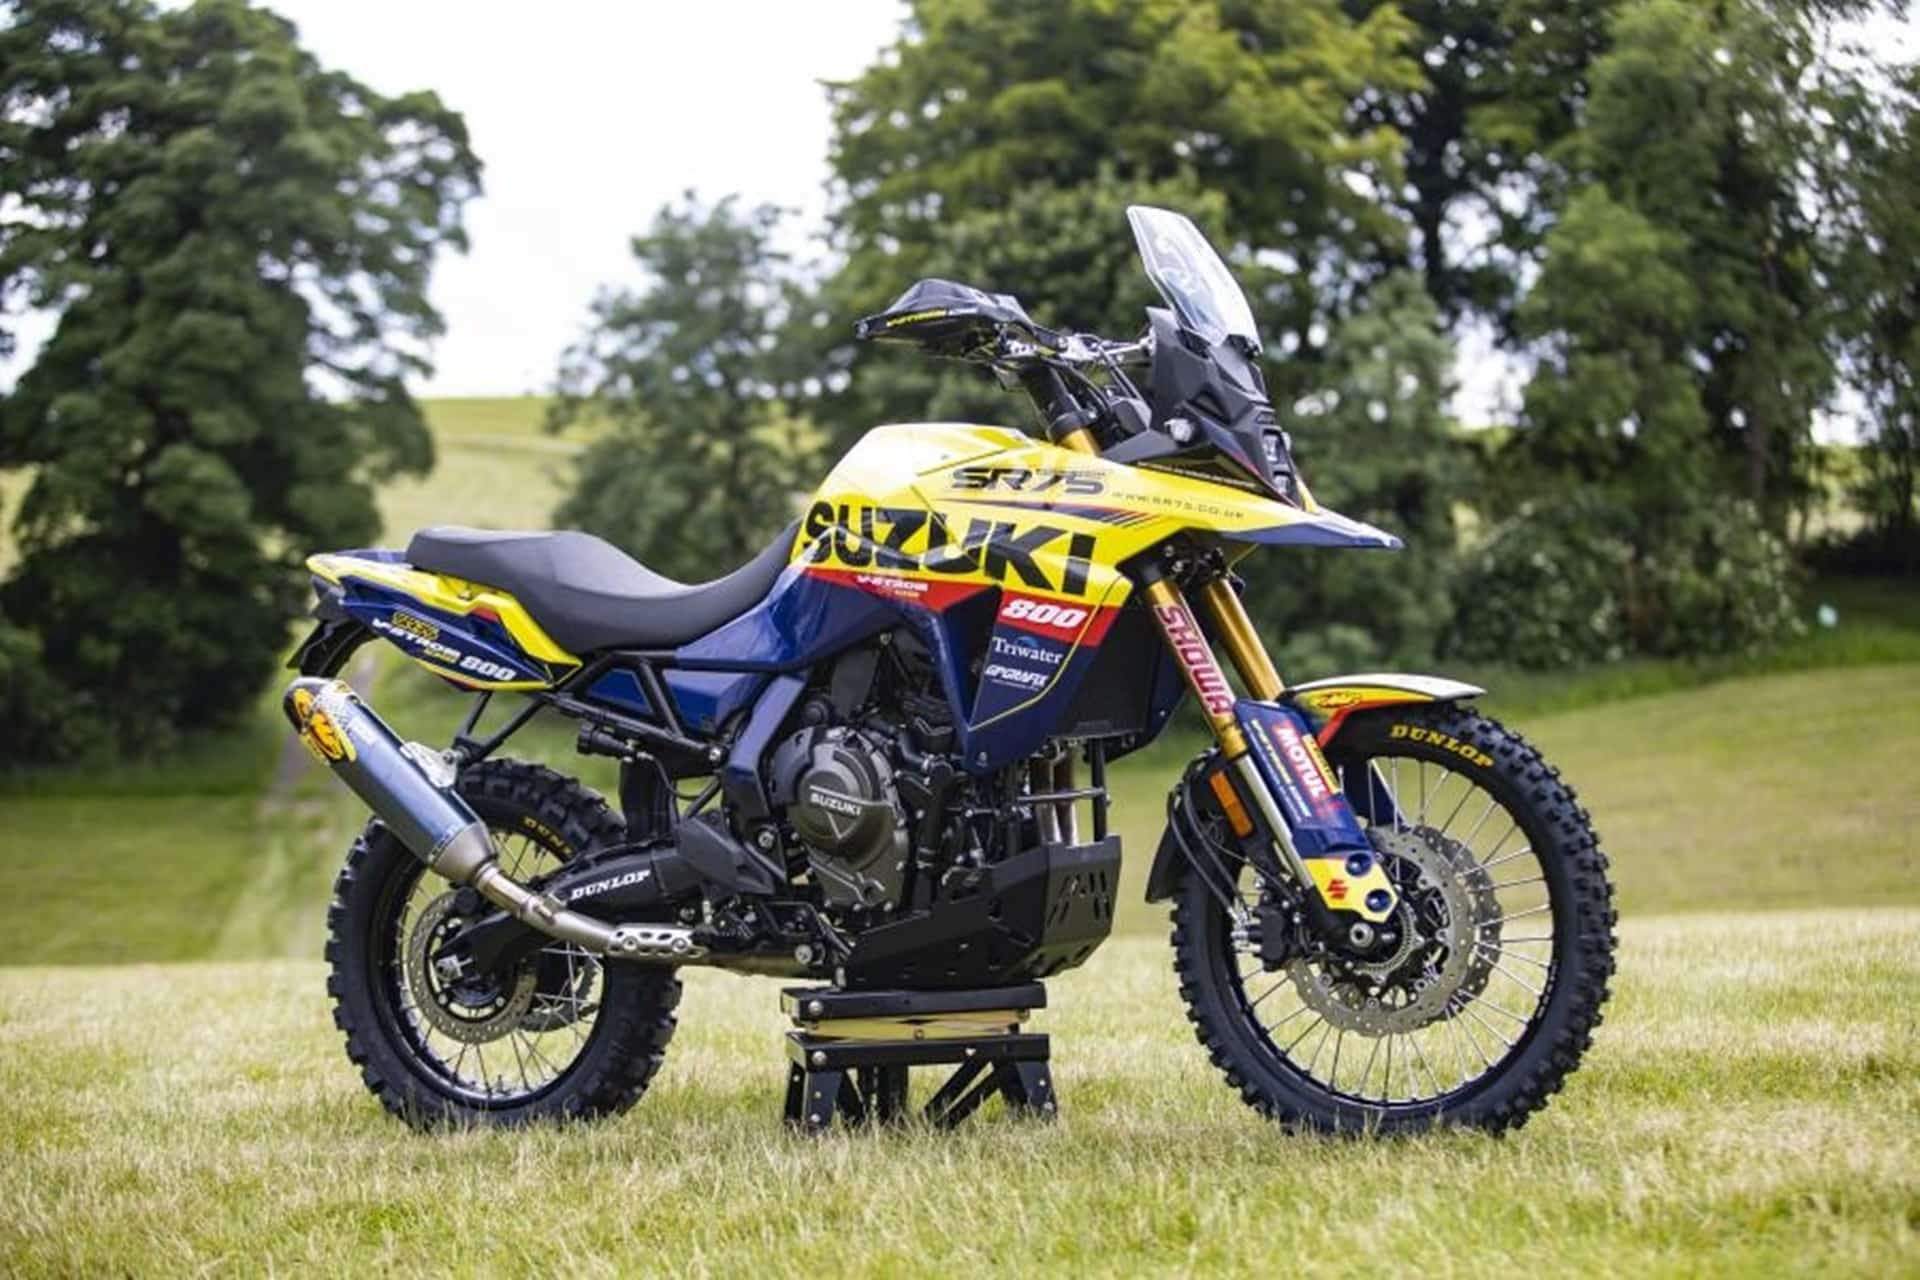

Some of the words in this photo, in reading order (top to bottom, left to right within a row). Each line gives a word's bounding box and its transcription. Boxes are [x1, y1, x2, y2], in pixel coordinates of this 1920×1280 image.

[951, 467, 1104, 494] SR75
[803, 501, 1097, 596] SUZUKI
[1001, 599, 1088, 628] 800
[991, 636, 1064, 664] Triwater
[1159, 605, 1234, 714] SHOWA
[460, 655, 517, 681] 800
[1273, 724, 1329, 798] MOTUL
[1389, 724, 1495, 769] DUNLOP
[810, 792, 862, 816] SUZUKI
[570, 869, 651, 901] DUNLOP
